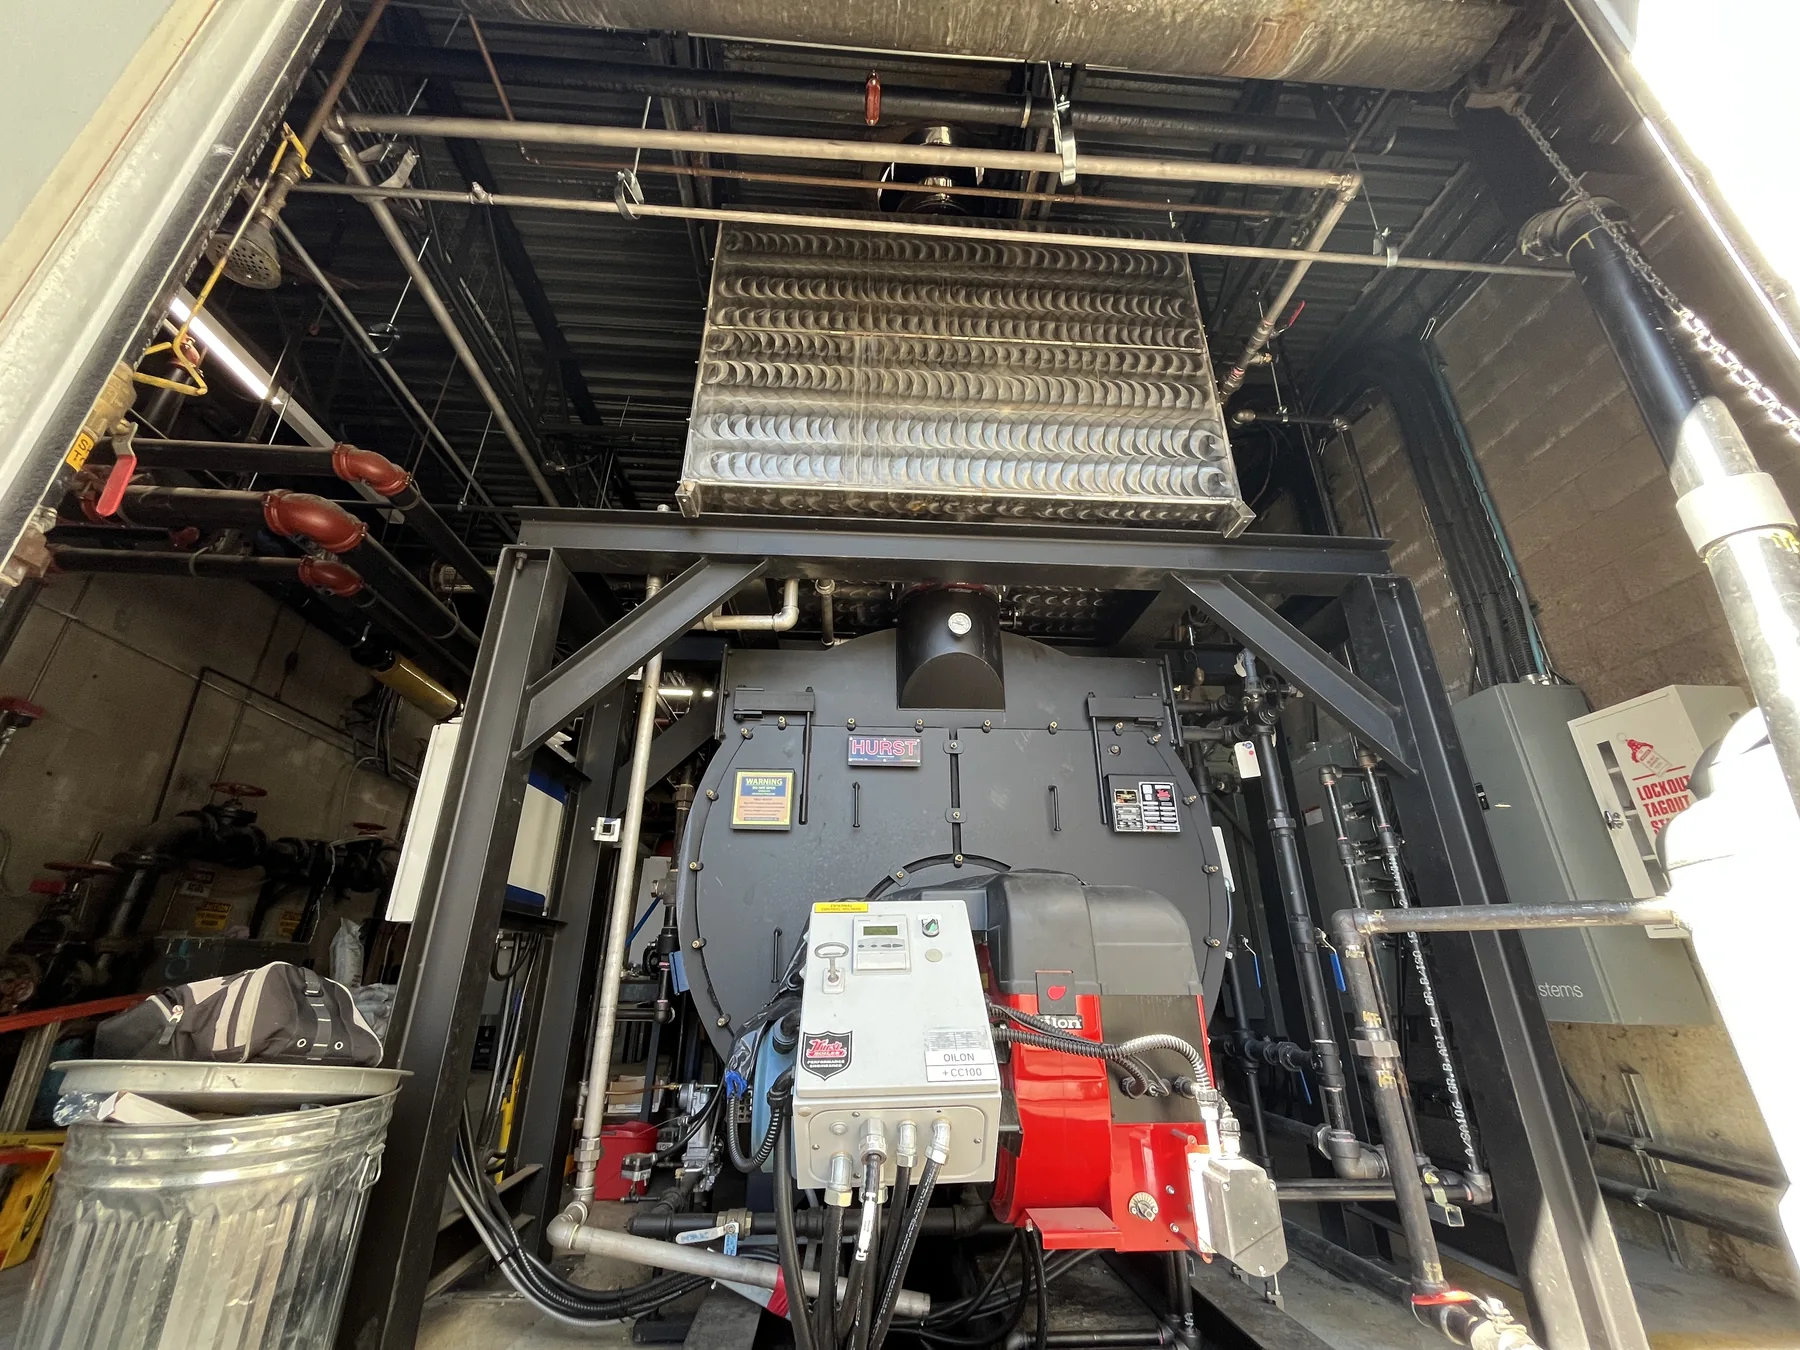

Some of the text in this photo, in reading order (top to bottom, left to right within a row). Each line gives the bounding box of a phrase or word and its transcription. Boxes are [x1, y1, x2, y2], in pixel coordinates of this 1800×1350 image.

[851, 739, 917, 756] HURST
[745, 778, 783, 786] WARNING
[1643, 795, 1691, 818] TAGOUT
[1538, 982, 1584, 998] stems
[1040, 1015, 1082, 1029] ilon
[808, 1039, 843, 1053] Hurst
[943, 1053, 975, 1062] OILON
